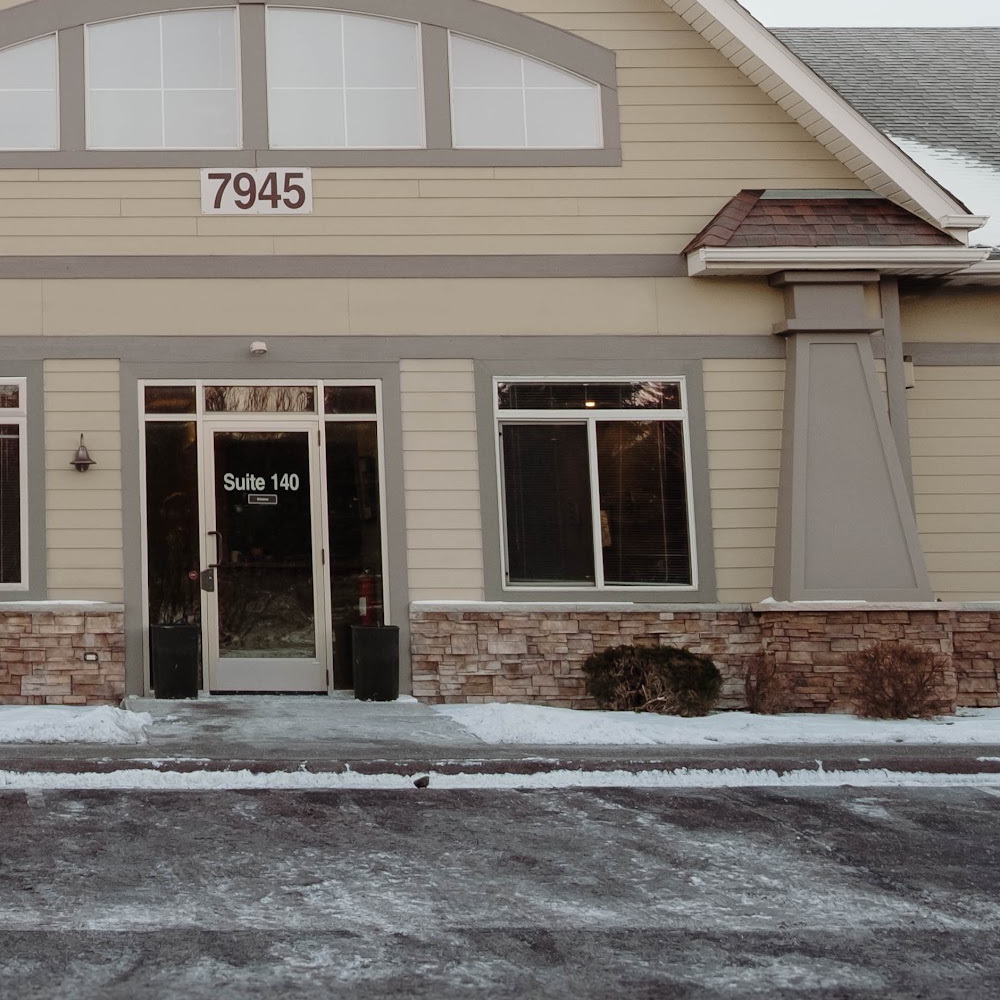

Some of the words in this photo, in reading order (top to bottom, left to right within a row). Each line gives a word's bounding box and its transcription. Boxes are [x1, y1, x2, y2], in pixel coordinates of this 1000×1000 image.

[208, 172, 306, 210] 7945
[223, 472, 266, 491] Suite
[270, 472, 300, 491] 140
